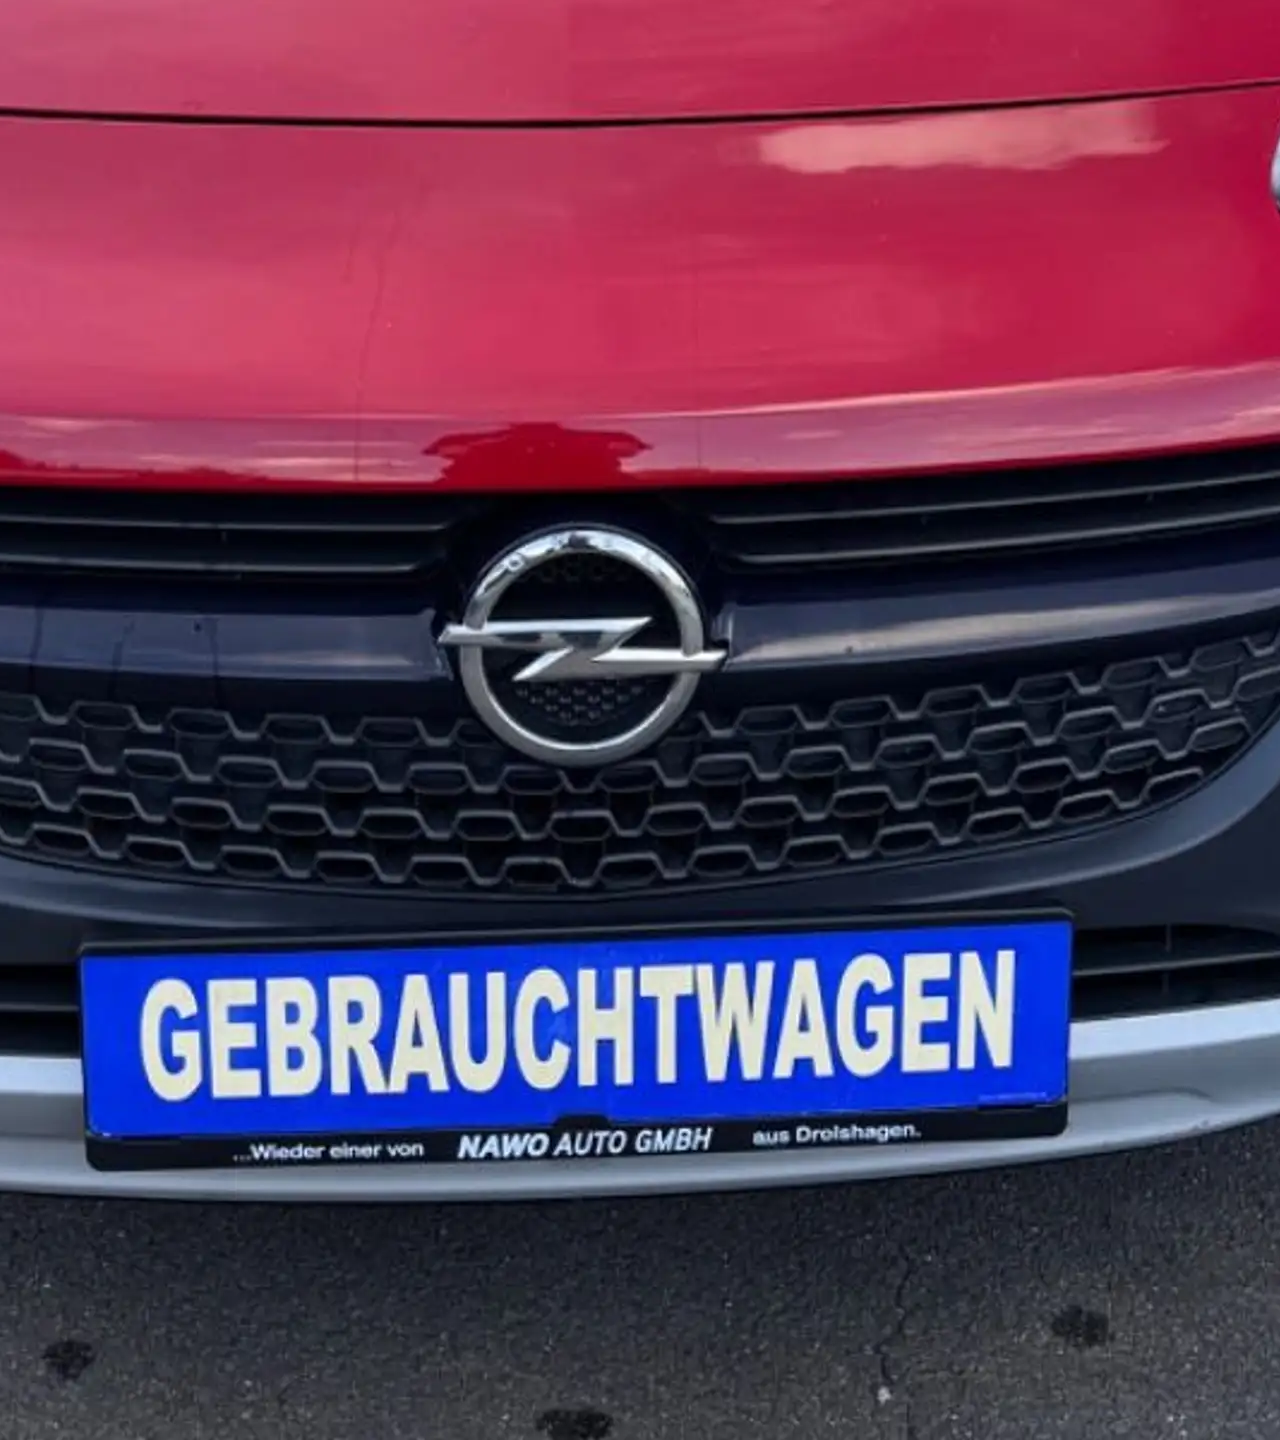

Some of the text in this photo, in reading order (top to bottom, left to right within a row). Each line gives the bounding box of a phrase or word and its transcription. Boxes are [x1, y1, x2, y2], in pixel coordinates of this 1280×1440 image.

[140, 950, 1016, 1101] GEBRAUCHTWAGEN
[329, 1142, 381, 1159] einer
[386, 1142, 424, 1157] von
[457, 1133, 550, 1159] NAWO
[553, 1129, 626, 1157] AUTO
[635, 1126, 713, 1153] GMBH
[752, 1130, 790, 1146] aus
